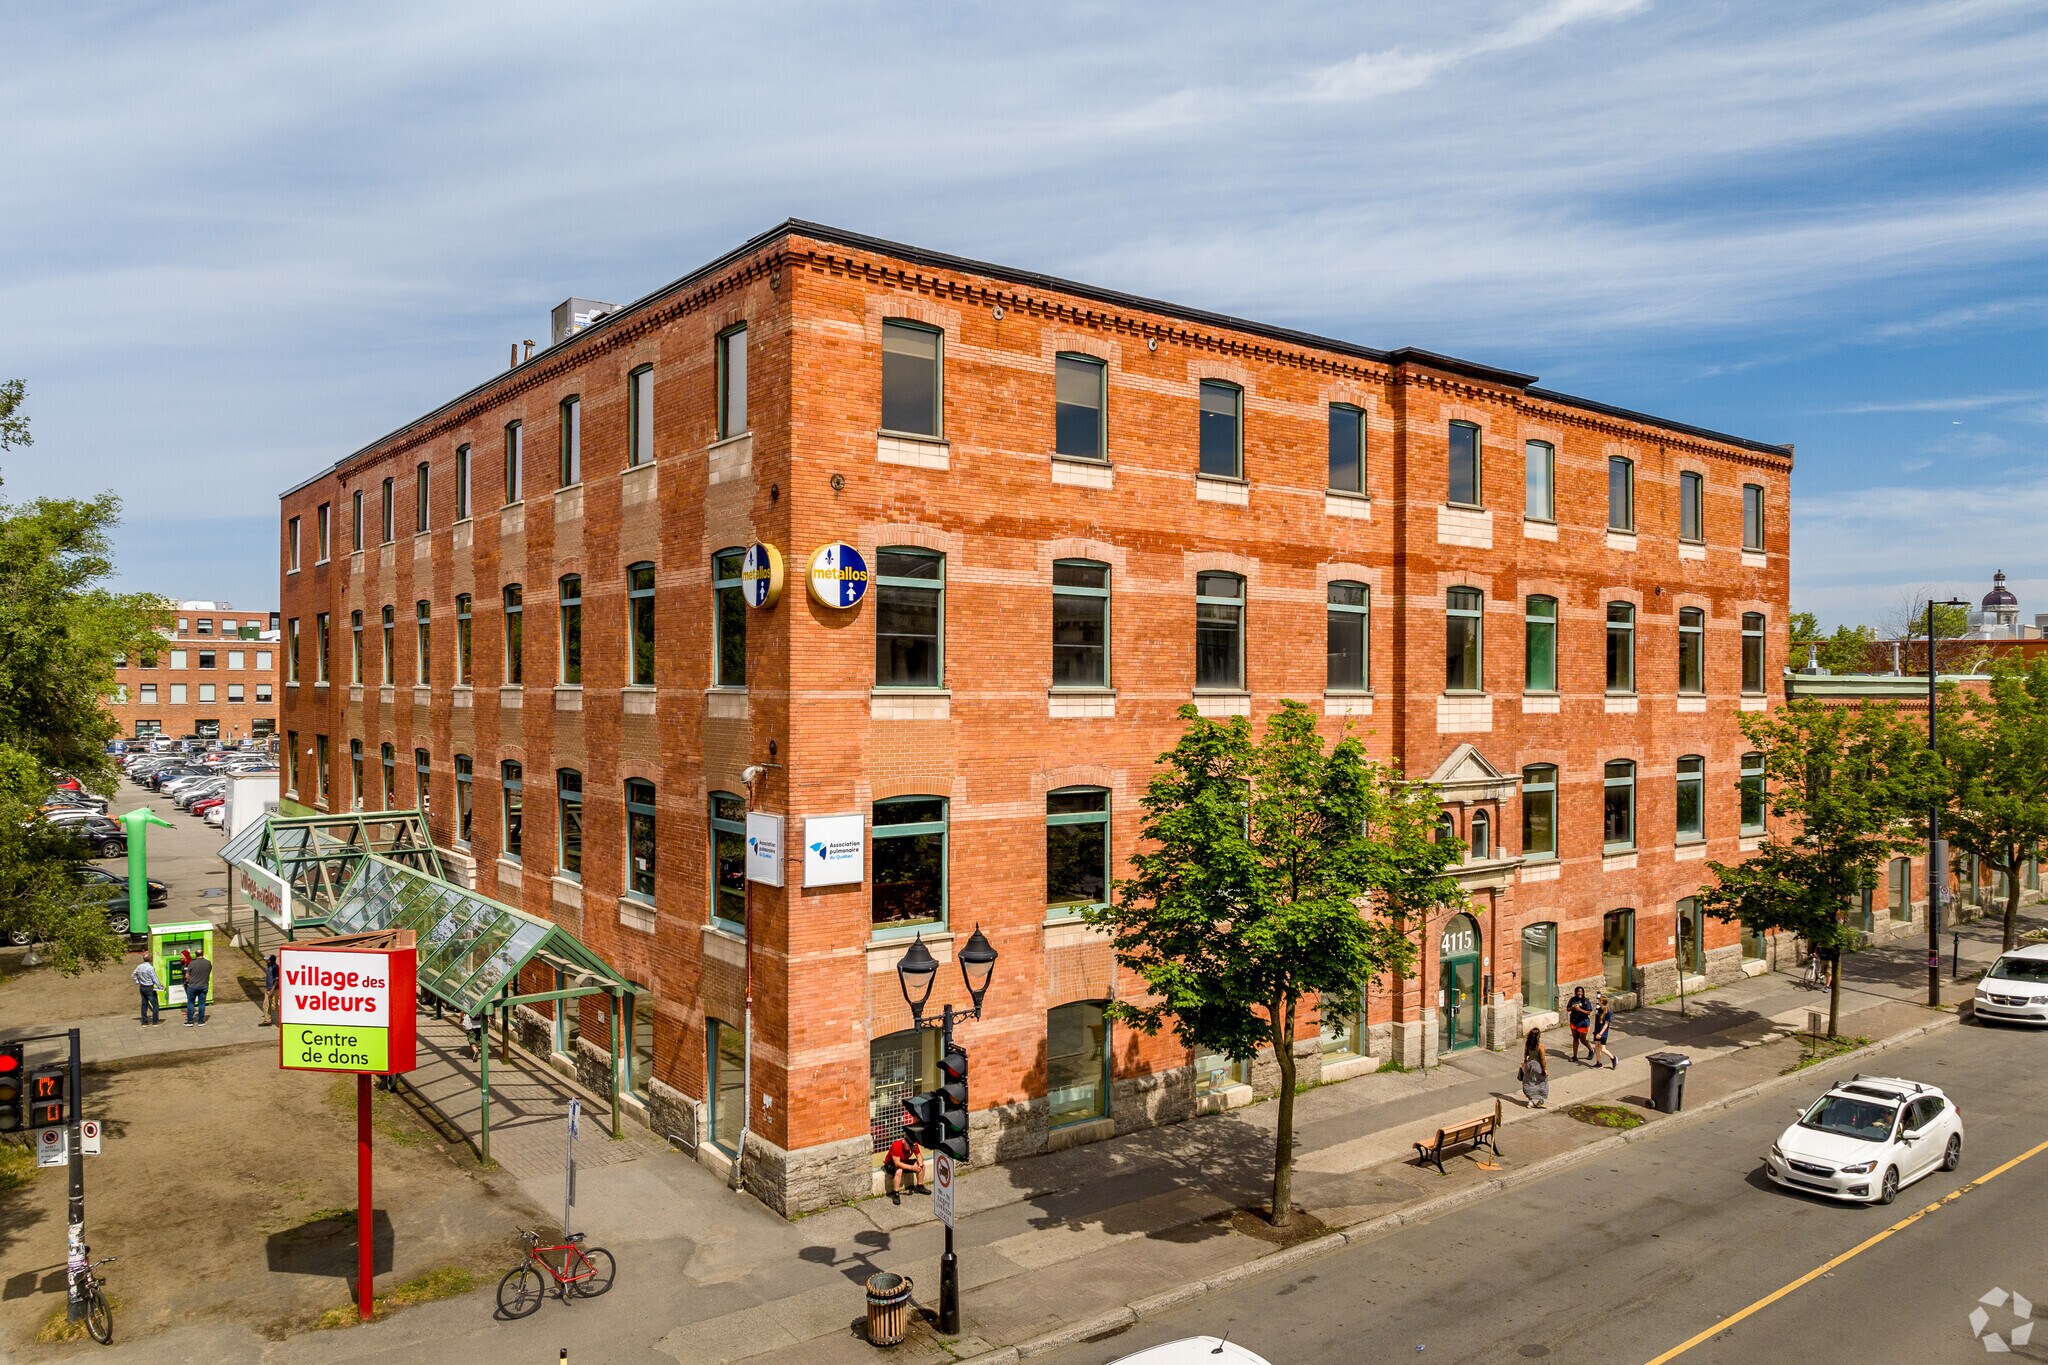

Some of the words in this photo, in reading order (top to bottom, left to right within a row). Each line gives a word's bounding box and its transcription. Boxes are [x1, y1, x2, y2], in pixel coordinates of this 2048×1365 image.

[742, 566, 771, 581] metallos
[814, 566, 868, 581] metallos
[759, 840, 776, 848] Association
[759, 846, 776, 854] pulmonaire
[829, 847, 859, 855] pulmonaire
[1441, 930, 1472, 952] 4115
[285, 965, 359, 991] village
[362, 976, 386, 988] des
[294, 991, 377, 1013] valeurs
[301, 1030, 358, 1047] Centre
[301, 1047, 322, 1063] de
[328, 1048, 369, 1065] dons
